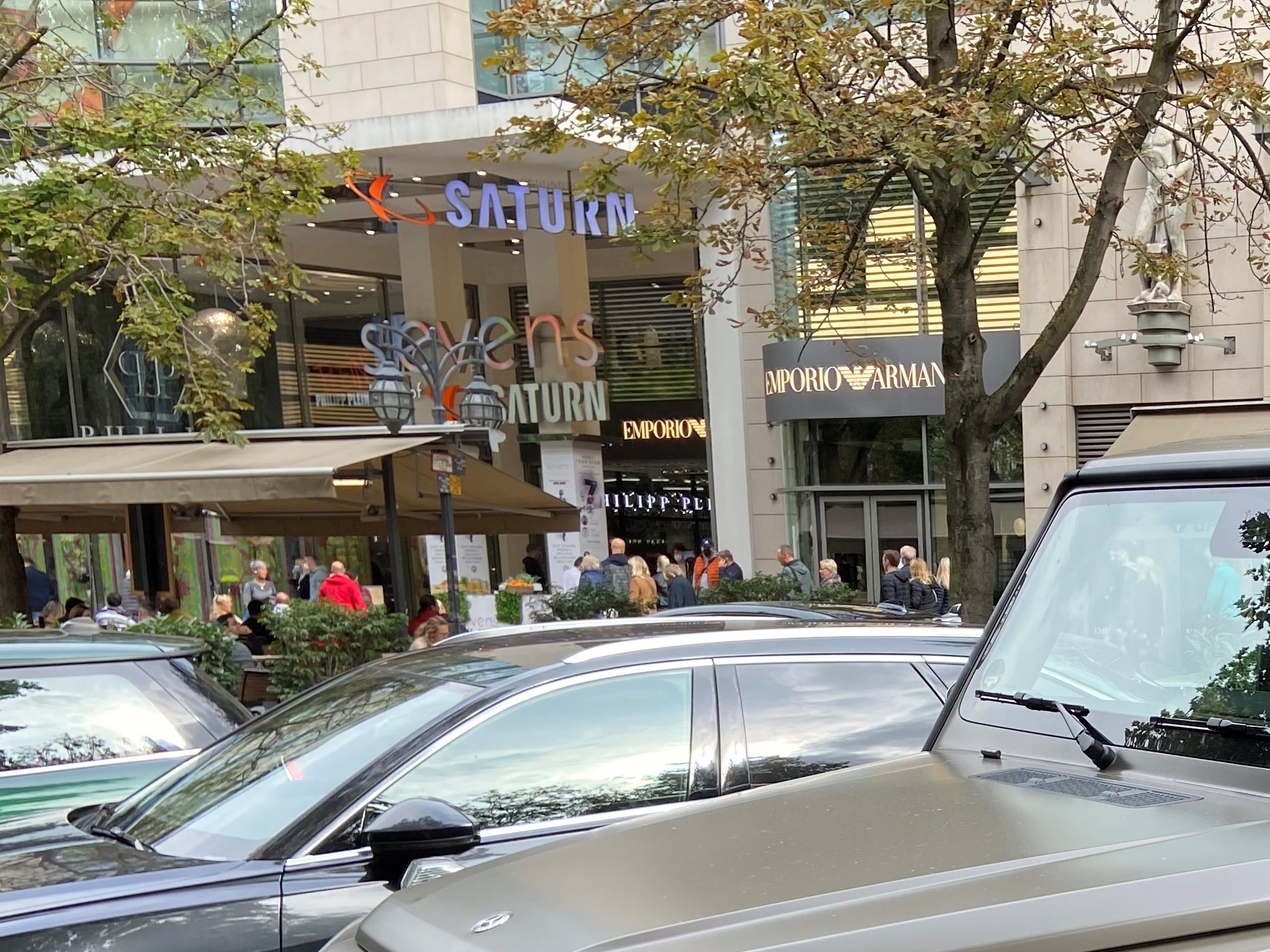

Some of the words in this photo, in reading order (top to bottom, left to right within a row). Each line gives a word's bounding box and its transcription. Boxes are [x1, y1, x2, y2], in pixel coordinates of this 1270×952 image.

[445, 180, 635, 237] SATURN
[361, 313, 602, 373] sevens
[765, 366, 842, 395] EMPORIO
[871, 362, 945, 390] ARMAN
[623, 420, 692, 439] EMPORIO
